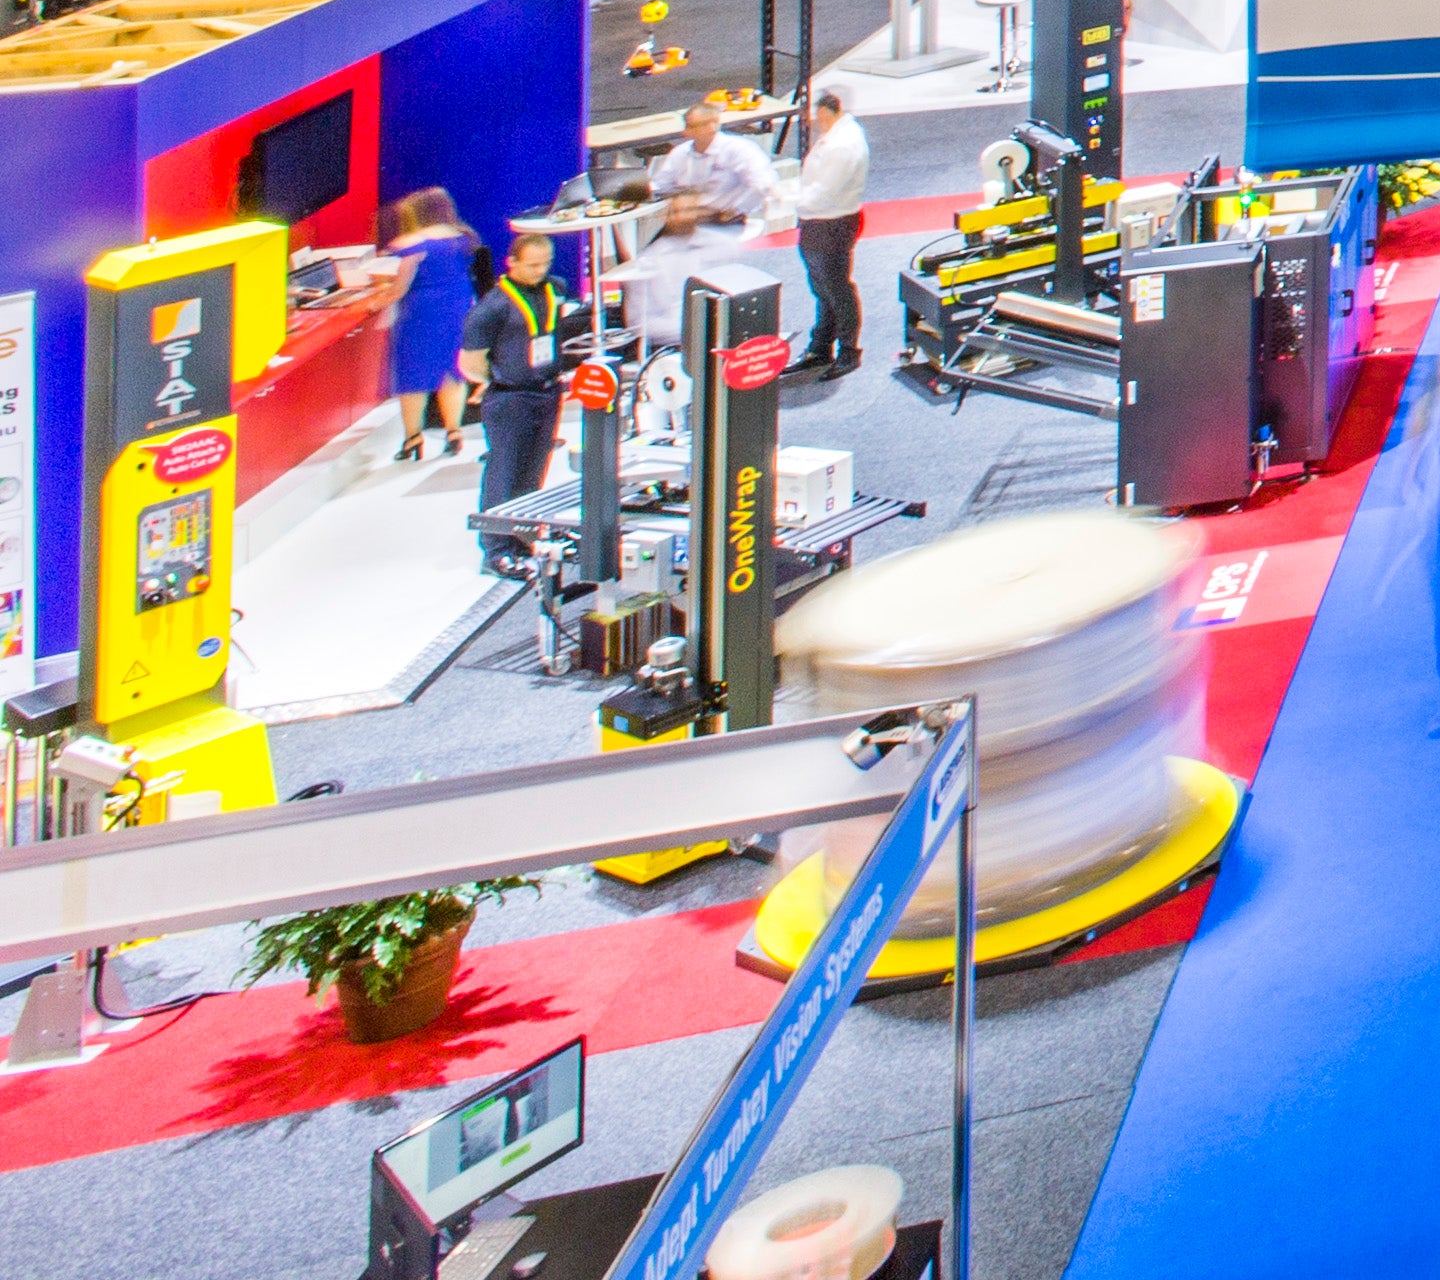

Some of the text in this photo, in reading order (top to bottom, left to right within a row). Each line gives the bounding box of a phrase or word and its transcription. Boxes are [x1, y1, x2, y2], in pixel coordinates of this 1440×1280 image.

[155, 337, 197, 417] SIAT
[728, 465, 763, 593] OneWrap
[645, 882, 885, 1280] Adept Turnkey Vision Systems
